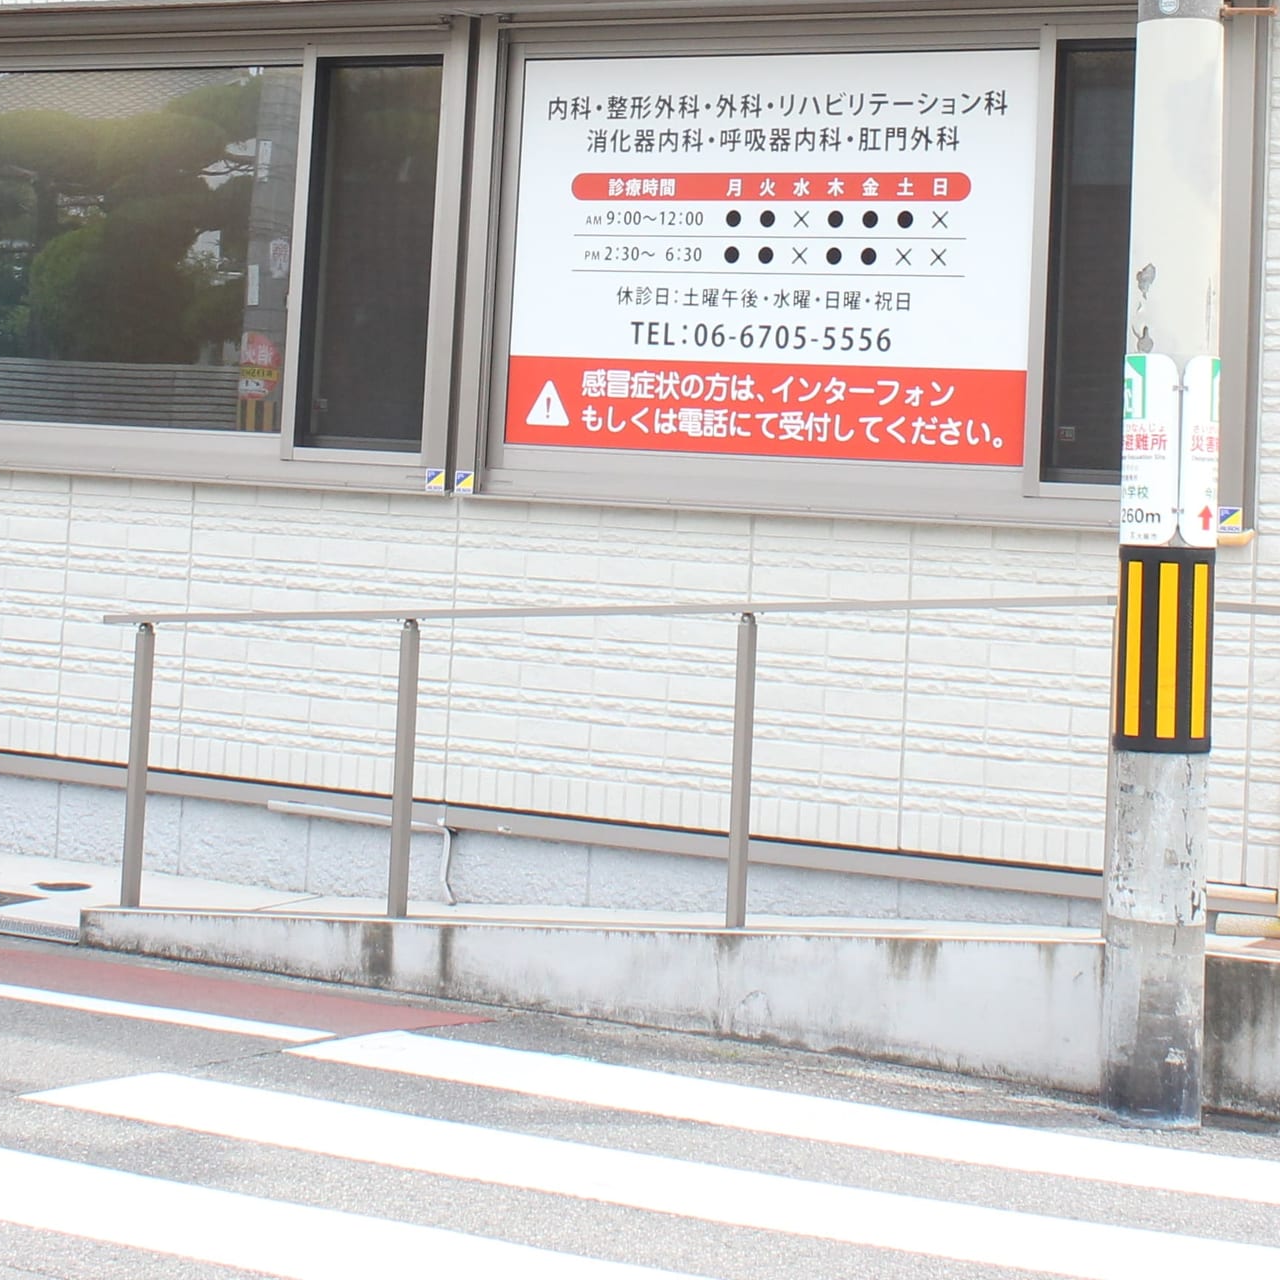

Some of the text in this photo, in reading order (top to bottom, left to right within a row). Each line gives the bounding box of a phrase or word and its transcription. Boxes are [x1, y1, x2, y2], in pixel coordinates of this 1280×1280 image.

[548, 89, 1008, 121] 内科・整形外科・外科・リハビリテーション科
[587, 125, 960, 153] 消化器内科・呼吸器内科・肛門外科
[608, 177, 948, 197] 診療時間 月 火 水 木 金 土 日
[586, 216, 602, 225] AM
[584, 251, 600, 260] PM
[665, 247, 702, 262] 6:30
[580, 369, 956, 408] 感冒症状の方は、インターフォン
[580, 405, 1005, 449] もしくは電話にて受付してください。
[1122, 508, 1161, 523] 260m
